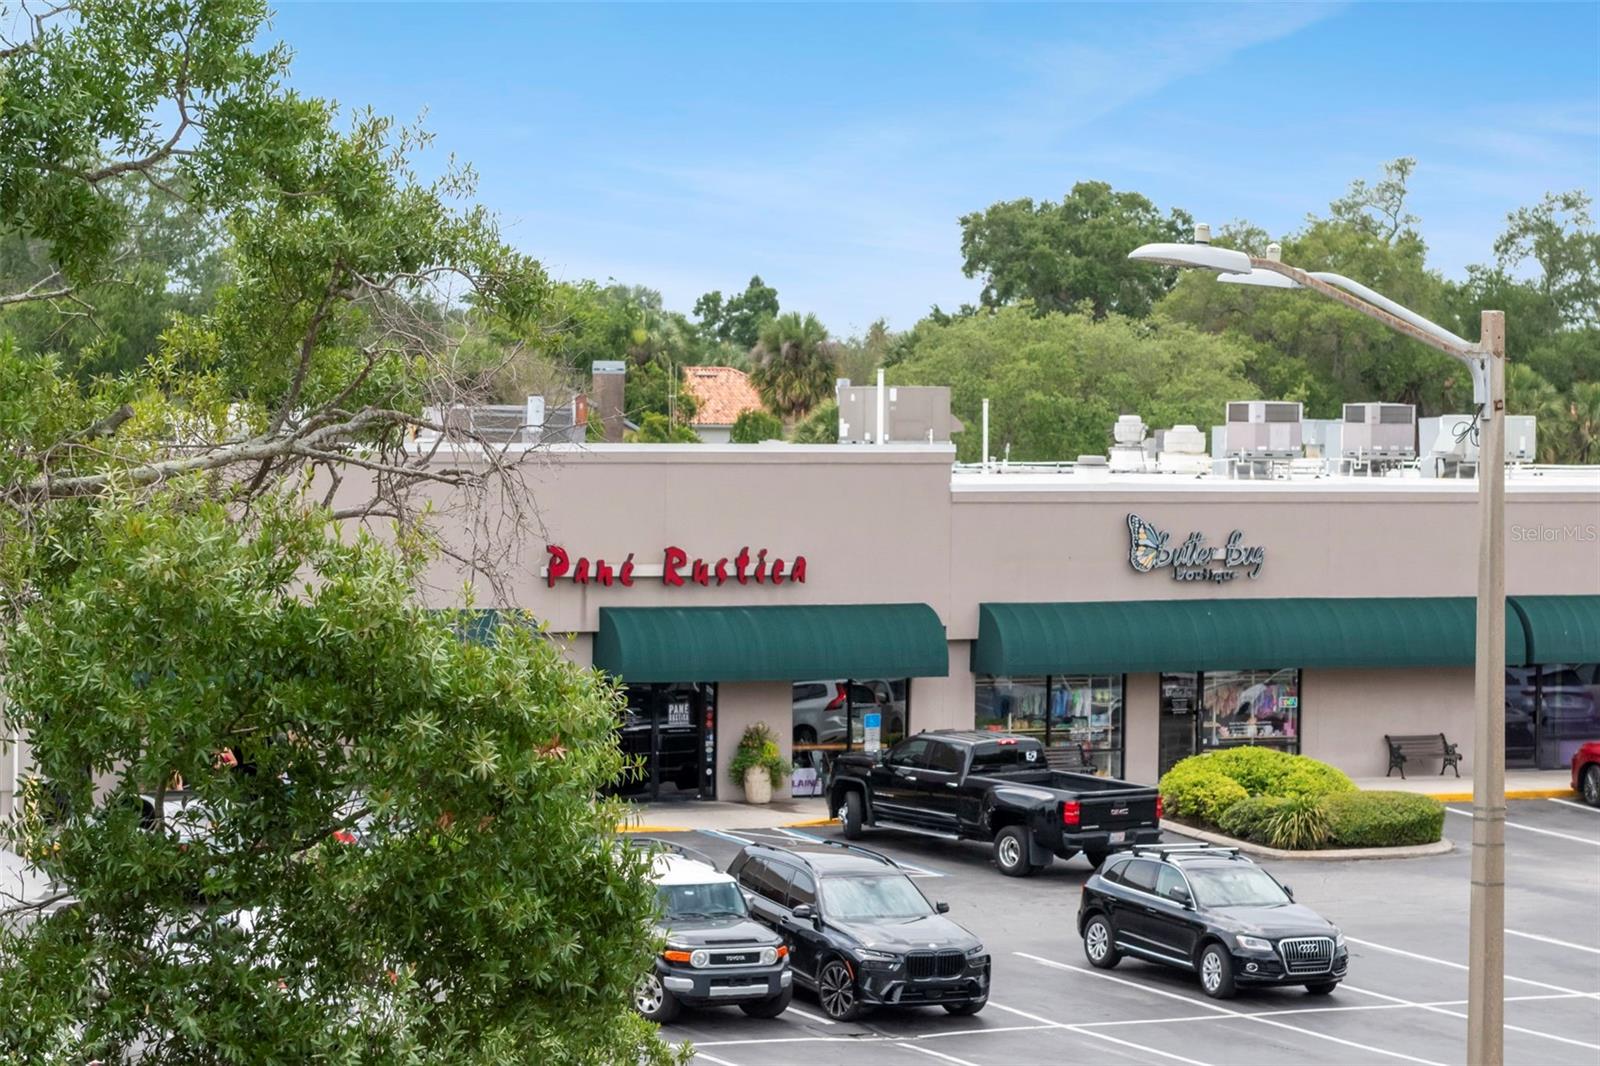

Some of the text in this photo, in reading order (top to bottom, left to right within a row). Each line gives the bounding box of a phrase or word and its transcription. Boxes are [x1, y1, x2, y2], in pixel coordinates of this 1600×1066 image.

[546, 545, 807, 587] Pané Rustica
[1153, 529, 1265, 580] Butter Bug
